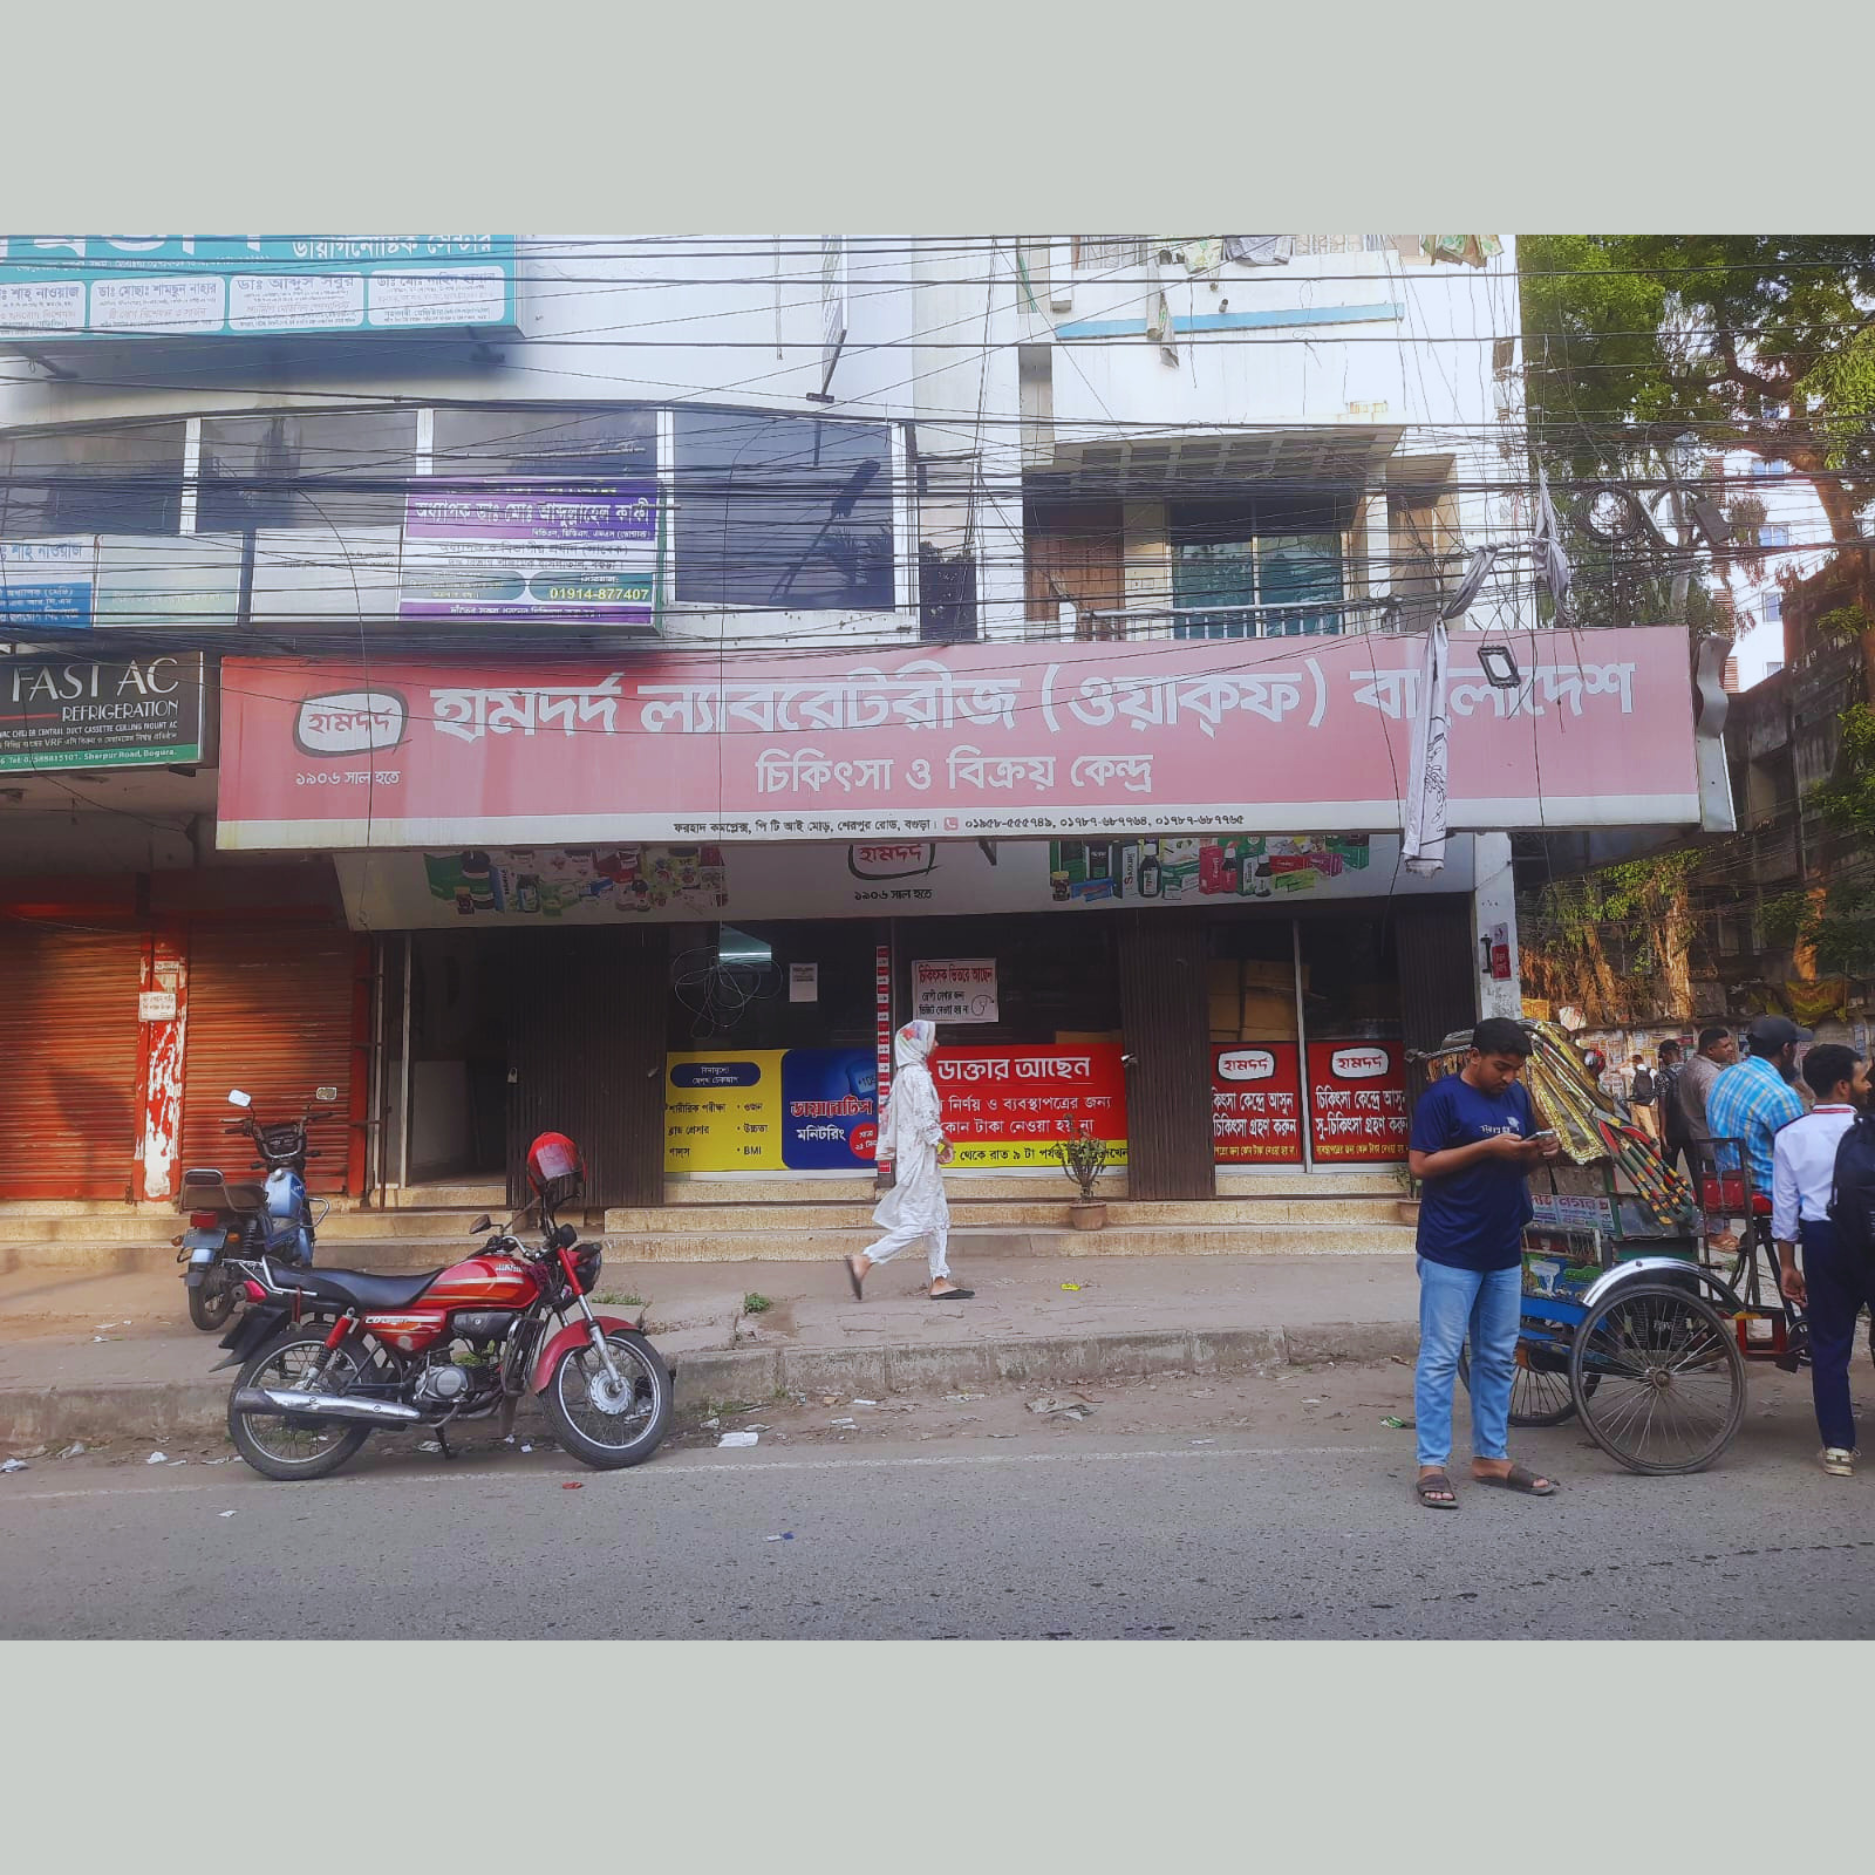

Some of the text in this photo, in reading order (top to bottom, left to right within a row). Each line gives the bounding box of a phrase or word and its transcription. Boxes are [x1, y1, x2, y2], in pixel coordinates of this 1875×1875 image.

[549, 587, 650, 601] 01914-877407
[12, 656, 179, 702] FAST AC
[61, 699, 179, 722] REFRIGERATION
[429, 672, 625, 743] হামদর্দ
[637, 659, 1021, 734] ল্যাবরেটরীজ
[1349, 662, 1636, 720] বালাদেশ
[38, 726, 63, 737] CENTRAL
[66, 725, 82, 735] DUCT
[84, 724, 114, 734] CASSETTE
[169, 720, 178, 729] AC
[308, 707, 392, 734] হামদর্দ
[296, 771, 401, 785] ১৯০৬ সাল হতে
[756, 744, 1154, 794] চিকিৎসা ও বিক্রয় কেন্দ্র
[673, 823, 707, 833] ফরহাদ
[755, 819, 768, 832] পি
[770, 819, 781, 832] টি
[784, 819, 804, 832] আই
[837, 819, 872, 832] শেরপুর
[858, 843, 924, 863] হামদর্দ
[854, 888, 933, 901] ১৯০৬ সাল হতে
[936, 1057, 1091, 1081] ডাক্তার আছেন
[1223, 1058, 1269, 1071] হামদর্দ
[1337, 1056, 1384, 1069] হামদর্দ
[790, 1093, 874, 1119] ডায়াবেটিস
[948, 1094, 1112, 1113] নির্ণয় ও ব্যবস্থাপত্রের জন্য
[1267, 1093, 1295, 1116] আসুন
[1315, 1085, 1352, 1110] চিকিৎসা
[796, 1125, 847, 1142] মনিটরিং
[974, 1118, 1004, 1134] টাকা
[1009, 1119, 1050, 1133] নেওয়া
[1079, 1118, 1095, 1133] না
[1271, 1118, 1297, 1137] করুন
[1315, 1111, 1363, 1141] সু-চিকিৎসা
[743, 1146, 762, 1155] BMI
[960, 1149, 987, 1161] থেকে
[989, 1150, 1010, 1161] রাত
[1013, 1151, 1021, 1161] ৯
[1024, 1147, 1036, 1159] টা
